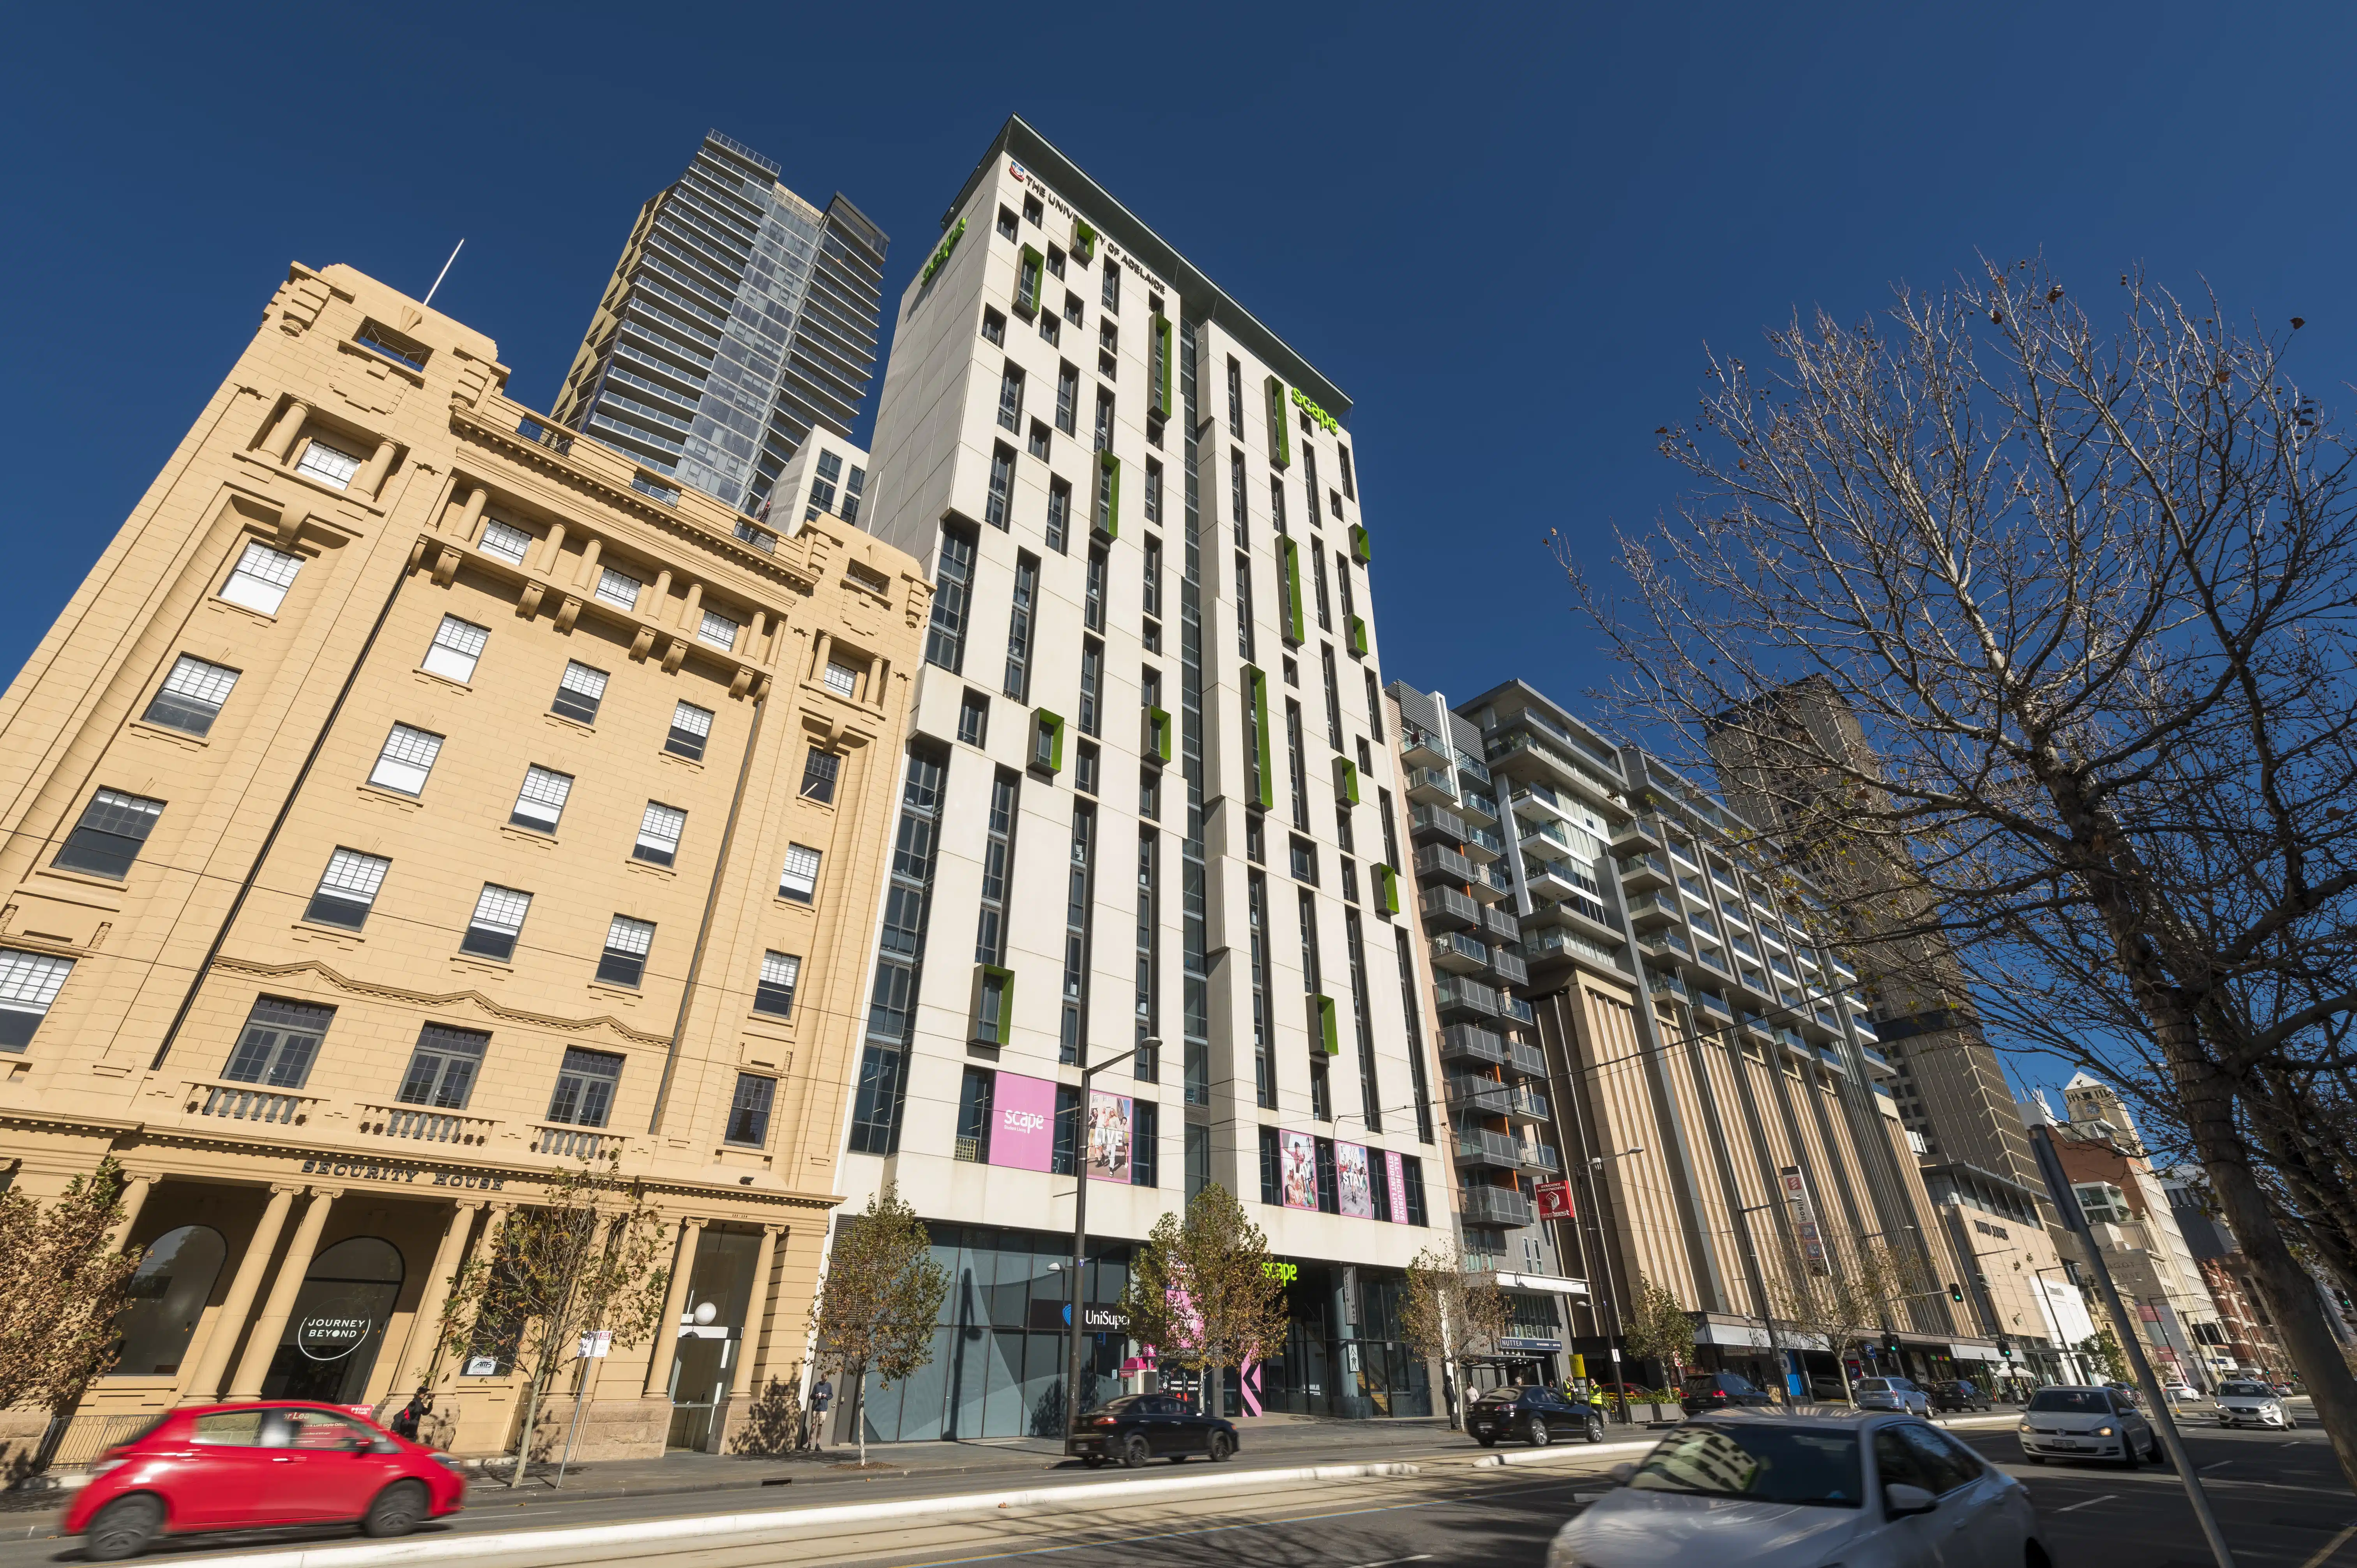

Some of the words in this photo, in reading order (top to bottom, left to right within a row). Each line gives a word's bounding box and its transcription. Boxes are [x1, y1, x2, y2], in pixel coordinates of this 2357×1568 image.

[1026, 175, 1046, 198] THE
[1048, 193, 1106, 246] UNIVETY
[1108, 242, 1120, 256] OF
[1121, 254, 1165, 296] ADELAIDE
[1291, 387, 1338, 436] scape
[1004, 1109, 1044, 1134] scape
[1095, 1128, 1123, 1146] LIVE
[301, 1160, 419, 1182] SECURITY
[433, 1172, 505, 1190] HOUSE
[1287, 1160, 1311, 1179] PLAY
[1343, 1171, 1364, 1188] STAY
[1388, 1155, 1397, 1191] STUDENT
[1393, 1155, 1405, 1221] ALL-INCLUSIVE
[308, 1319, 366, 1328] JOURNEY
